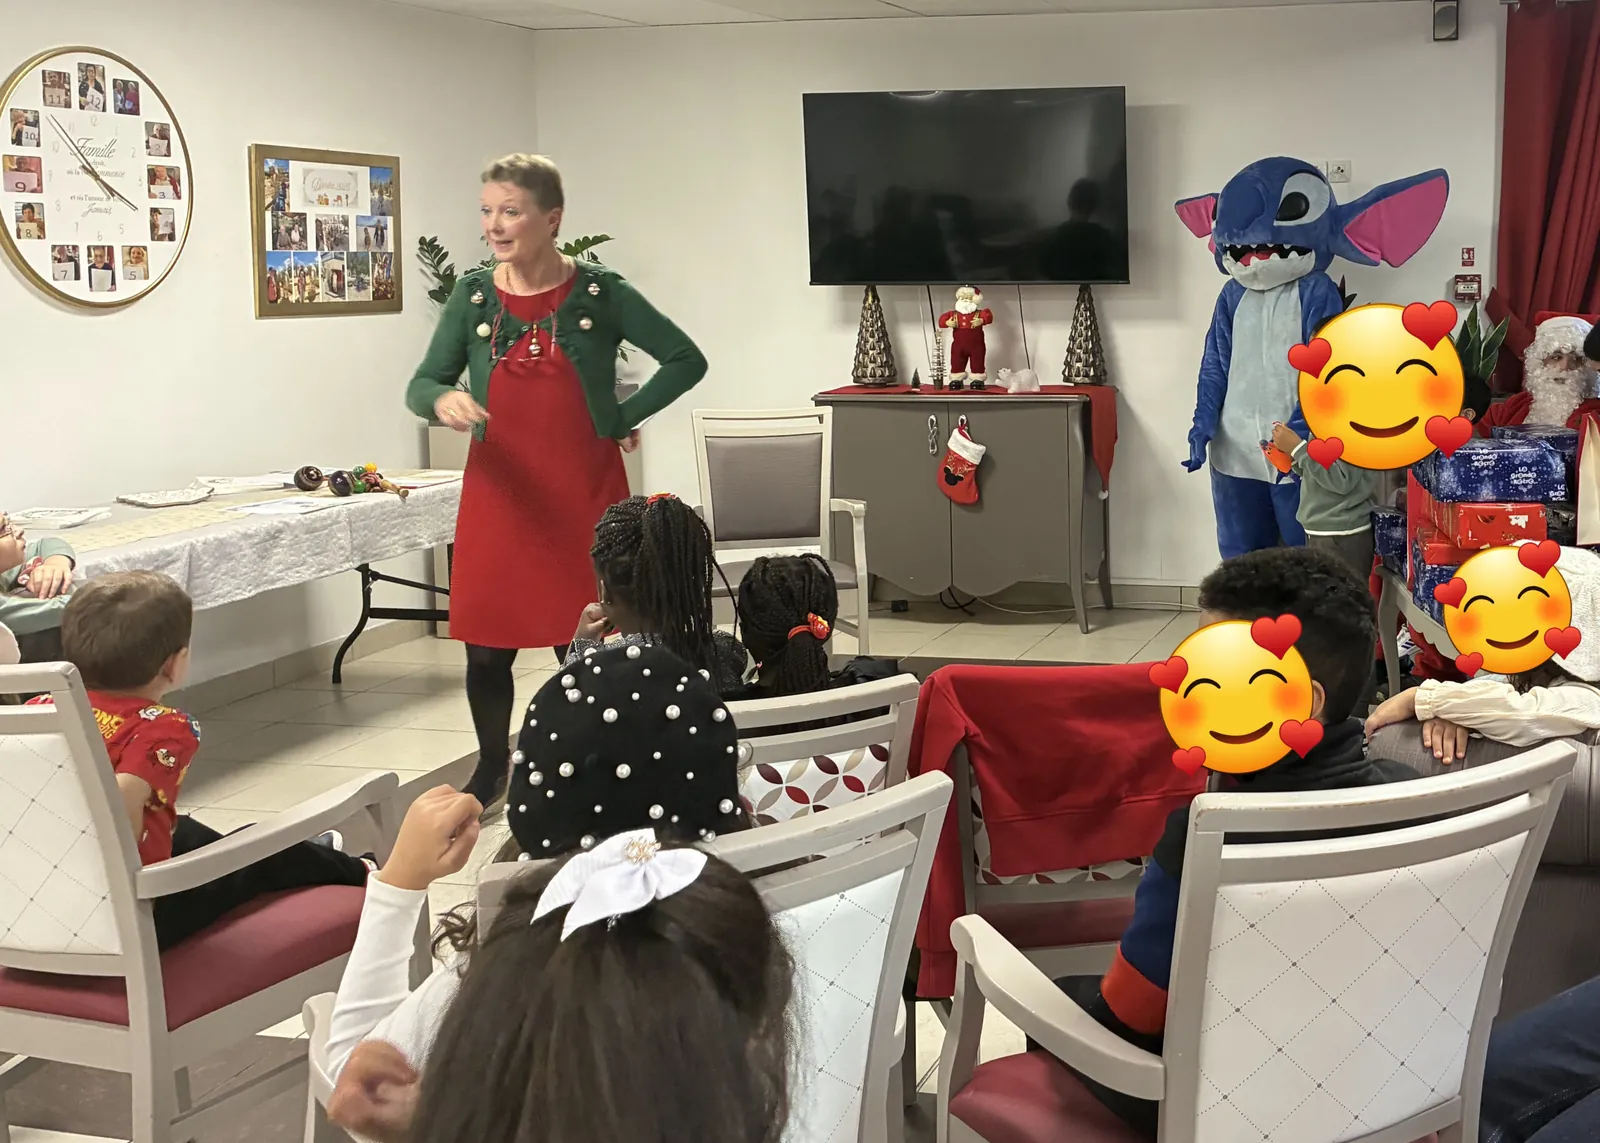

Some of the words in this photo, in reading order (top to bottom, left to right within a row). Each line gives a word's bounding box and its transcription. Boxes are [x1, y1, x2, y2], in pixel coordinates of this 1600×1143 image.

[48, 94, 62, 105] 11
[90, 94, 101, 110] 12
[24, 131, 36, 141] 10
[131, 146, 137, 159] 2
[15, 181, 26, 193] 9
[158, 191, 166, 199] 3
[25, 228, 32, 239] 8
[119, 223, 124, 235] 5
[97, 230, 103, 242] 6
[60, 270, 68, 280] 7
[129, 270, 137, 280] 5
